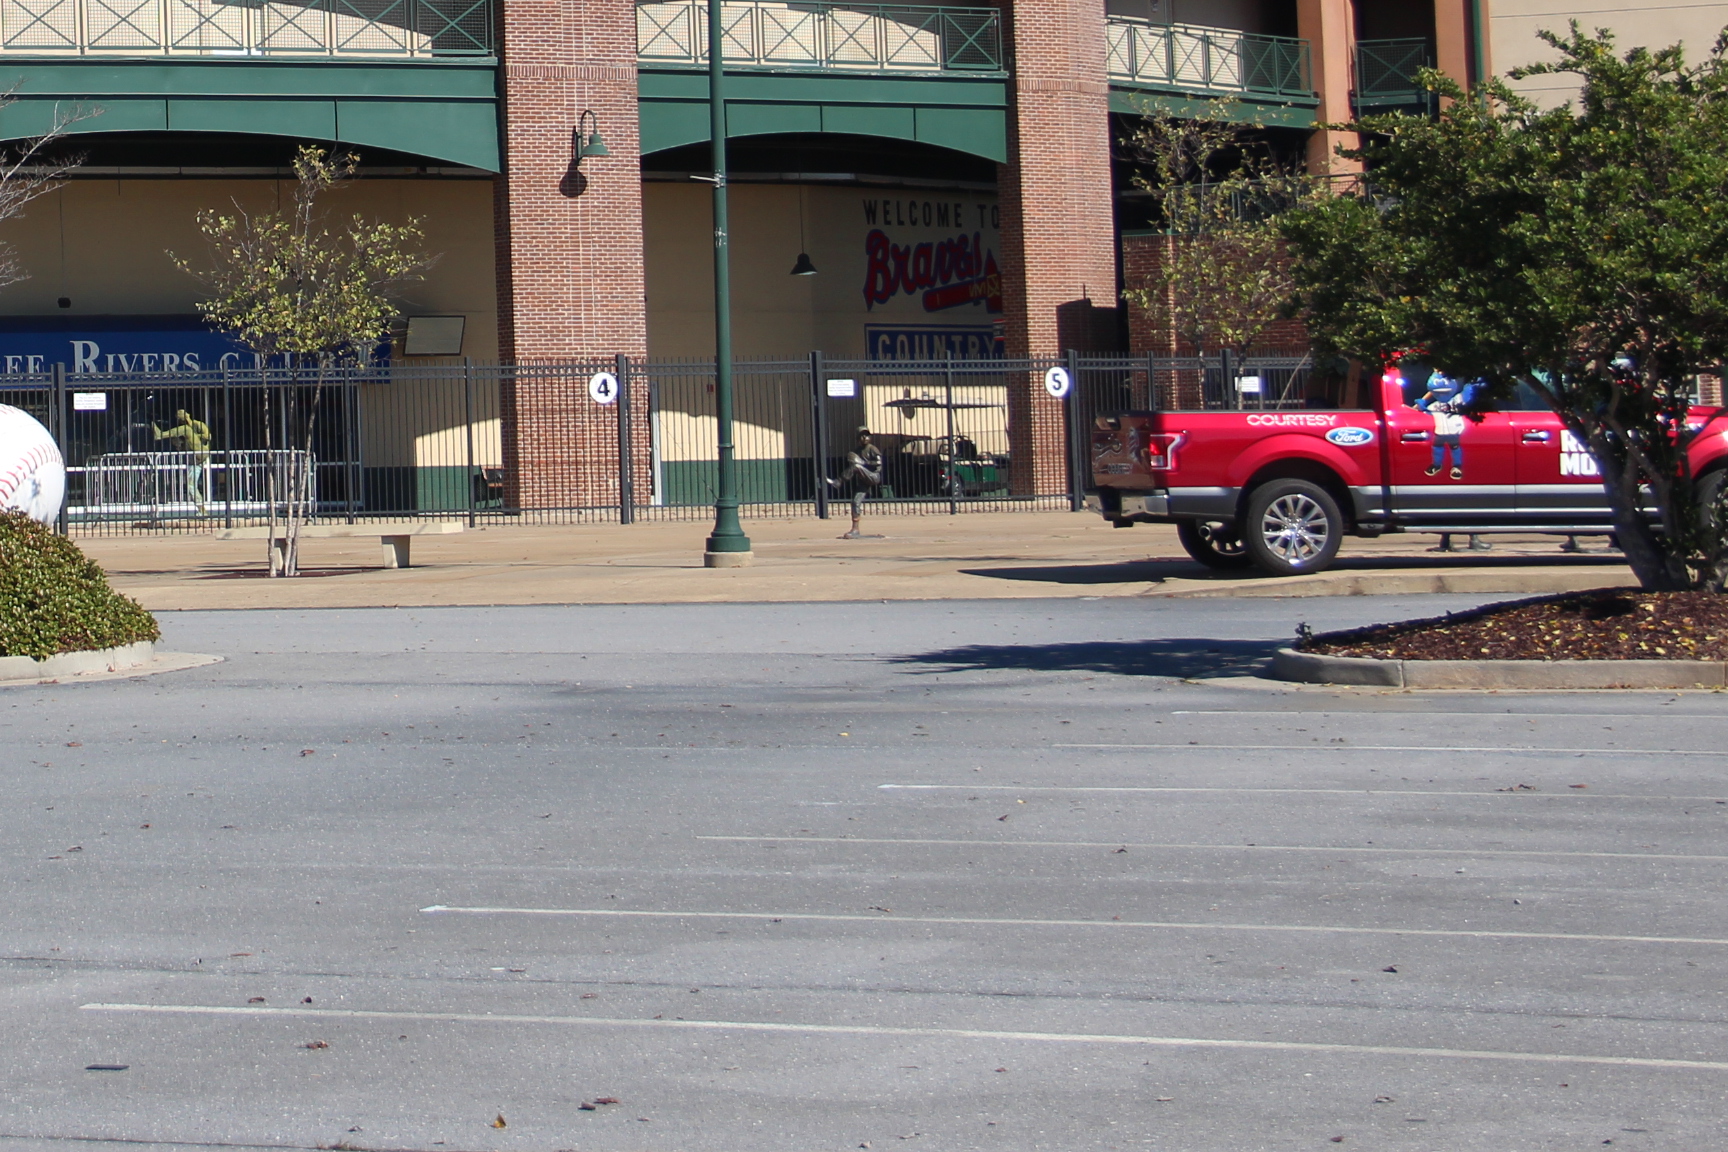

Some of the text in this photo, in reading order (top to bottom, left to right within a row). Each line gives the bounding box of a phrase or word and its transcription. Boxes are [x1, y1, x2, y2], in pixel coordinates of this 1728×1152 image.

[863, 200, 1000, 229] WELCOME TO
[863, 229, 982, 311] Braves
[69, 340, 200, 379] RIVERS
[877, 334, 997, 363] COUNTRY
[597, 378, 610, 397] 4
[1052, 373, 1062, 391] 5
[1246, 414, 1337, 427] COURTESY
[1335, 429, 1364, 442] Ford
